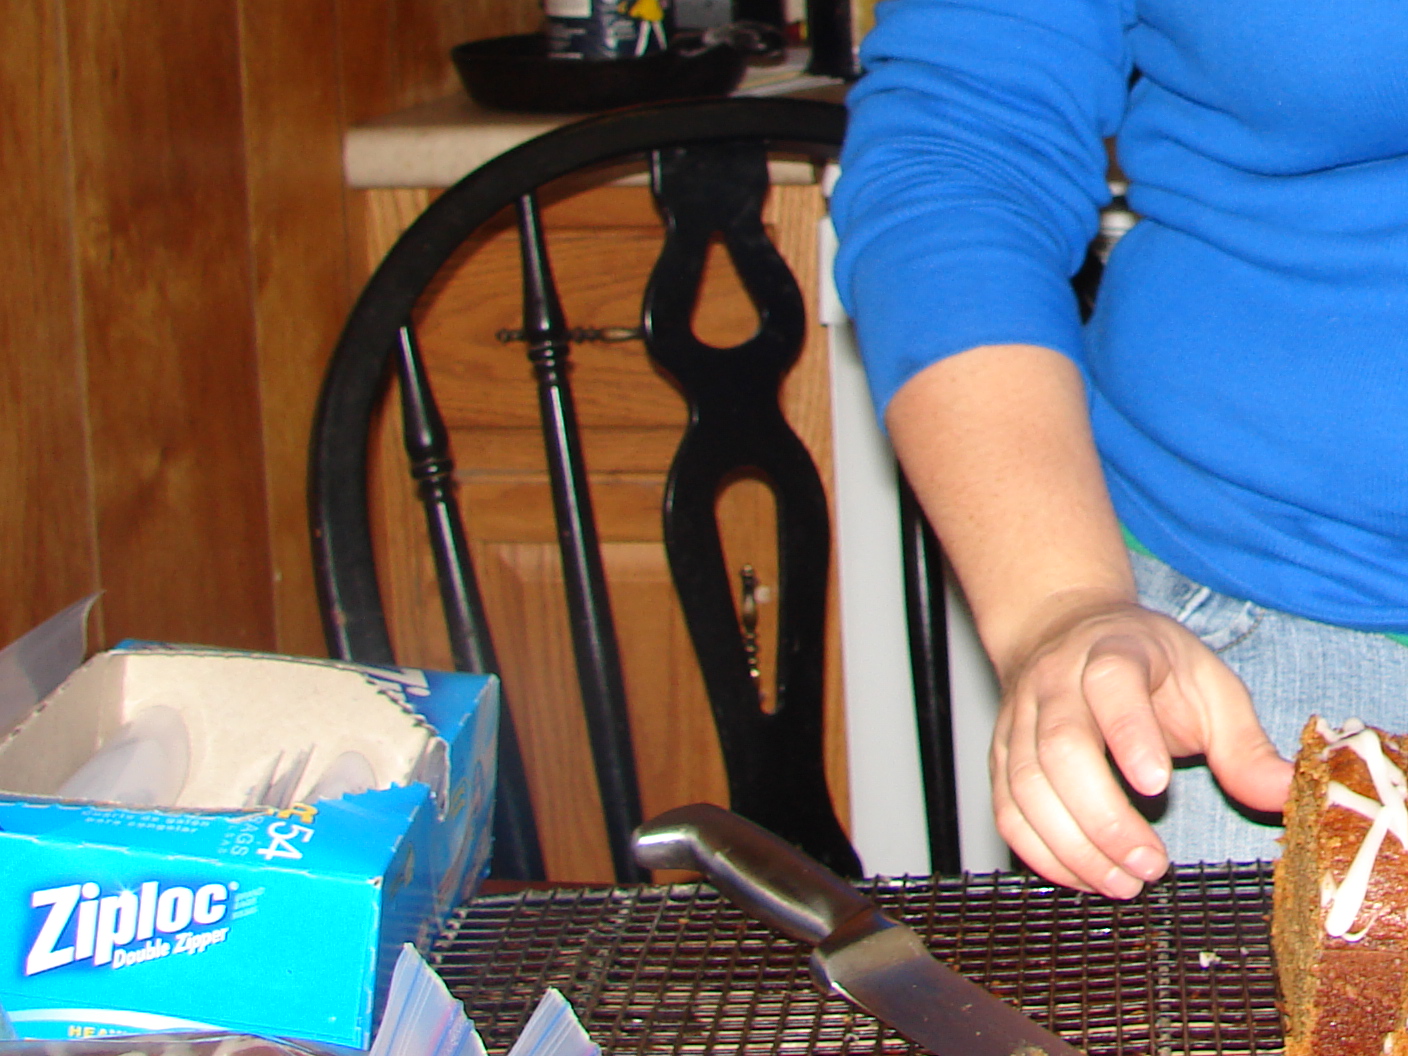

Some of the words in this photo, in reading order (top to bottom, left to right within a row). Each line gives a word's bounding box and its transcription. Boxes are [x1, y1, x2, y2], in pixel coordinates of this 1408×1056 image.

[256, 820, 315, 861] 54
[25, 881, 228, 977] Ziploc
[112, 938, 171, 970] Double
[172, 927, 230, 956] Zipper
